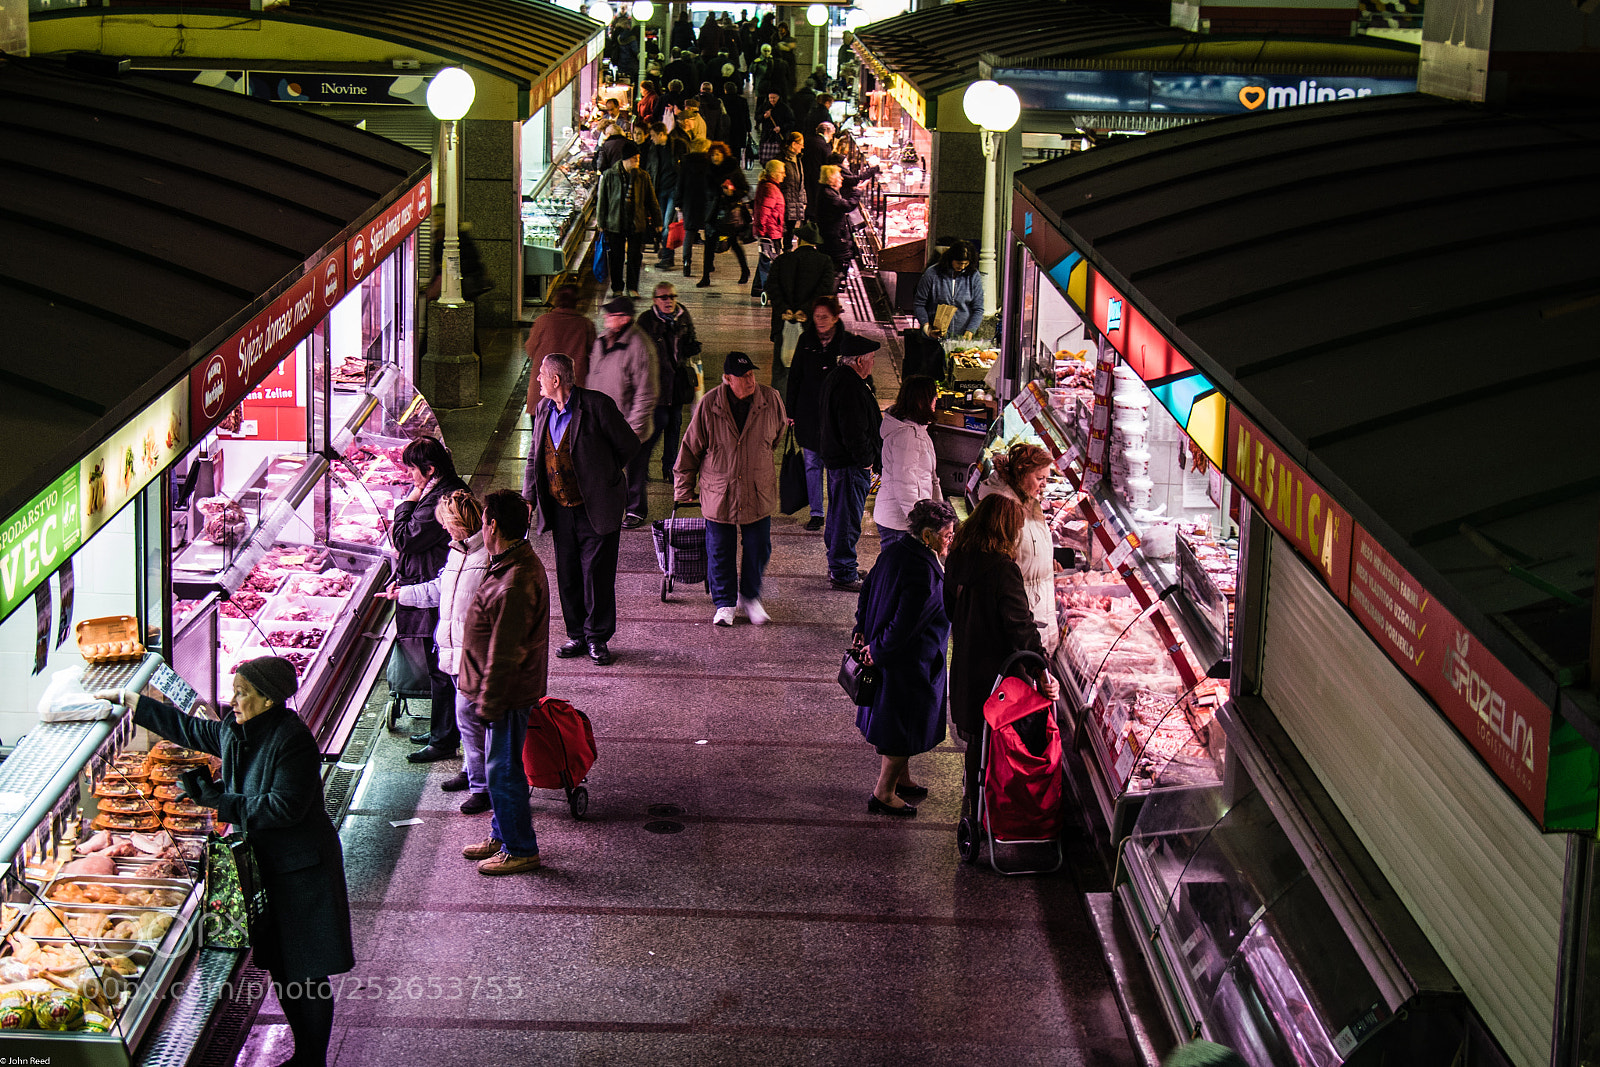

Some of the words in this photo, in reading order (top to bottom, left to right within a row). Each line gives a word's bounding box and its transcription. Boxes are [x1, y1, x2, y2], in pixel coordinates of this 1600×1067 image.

[321, 83, 367, 95] iNovine
[1267, 80, 1372, 110] mlinar
[237, 325, 263, 385] Svježe
[293, 276, 316, 328] meso!
[265, 387, 293, 400] Zeline
[952, 471, 964, 483] 10
[1235, 424, 1333, 577] MESNICA
[0, 514, 58, 602] VEC
[1393, 601, 1416, 636] UZGOJA
